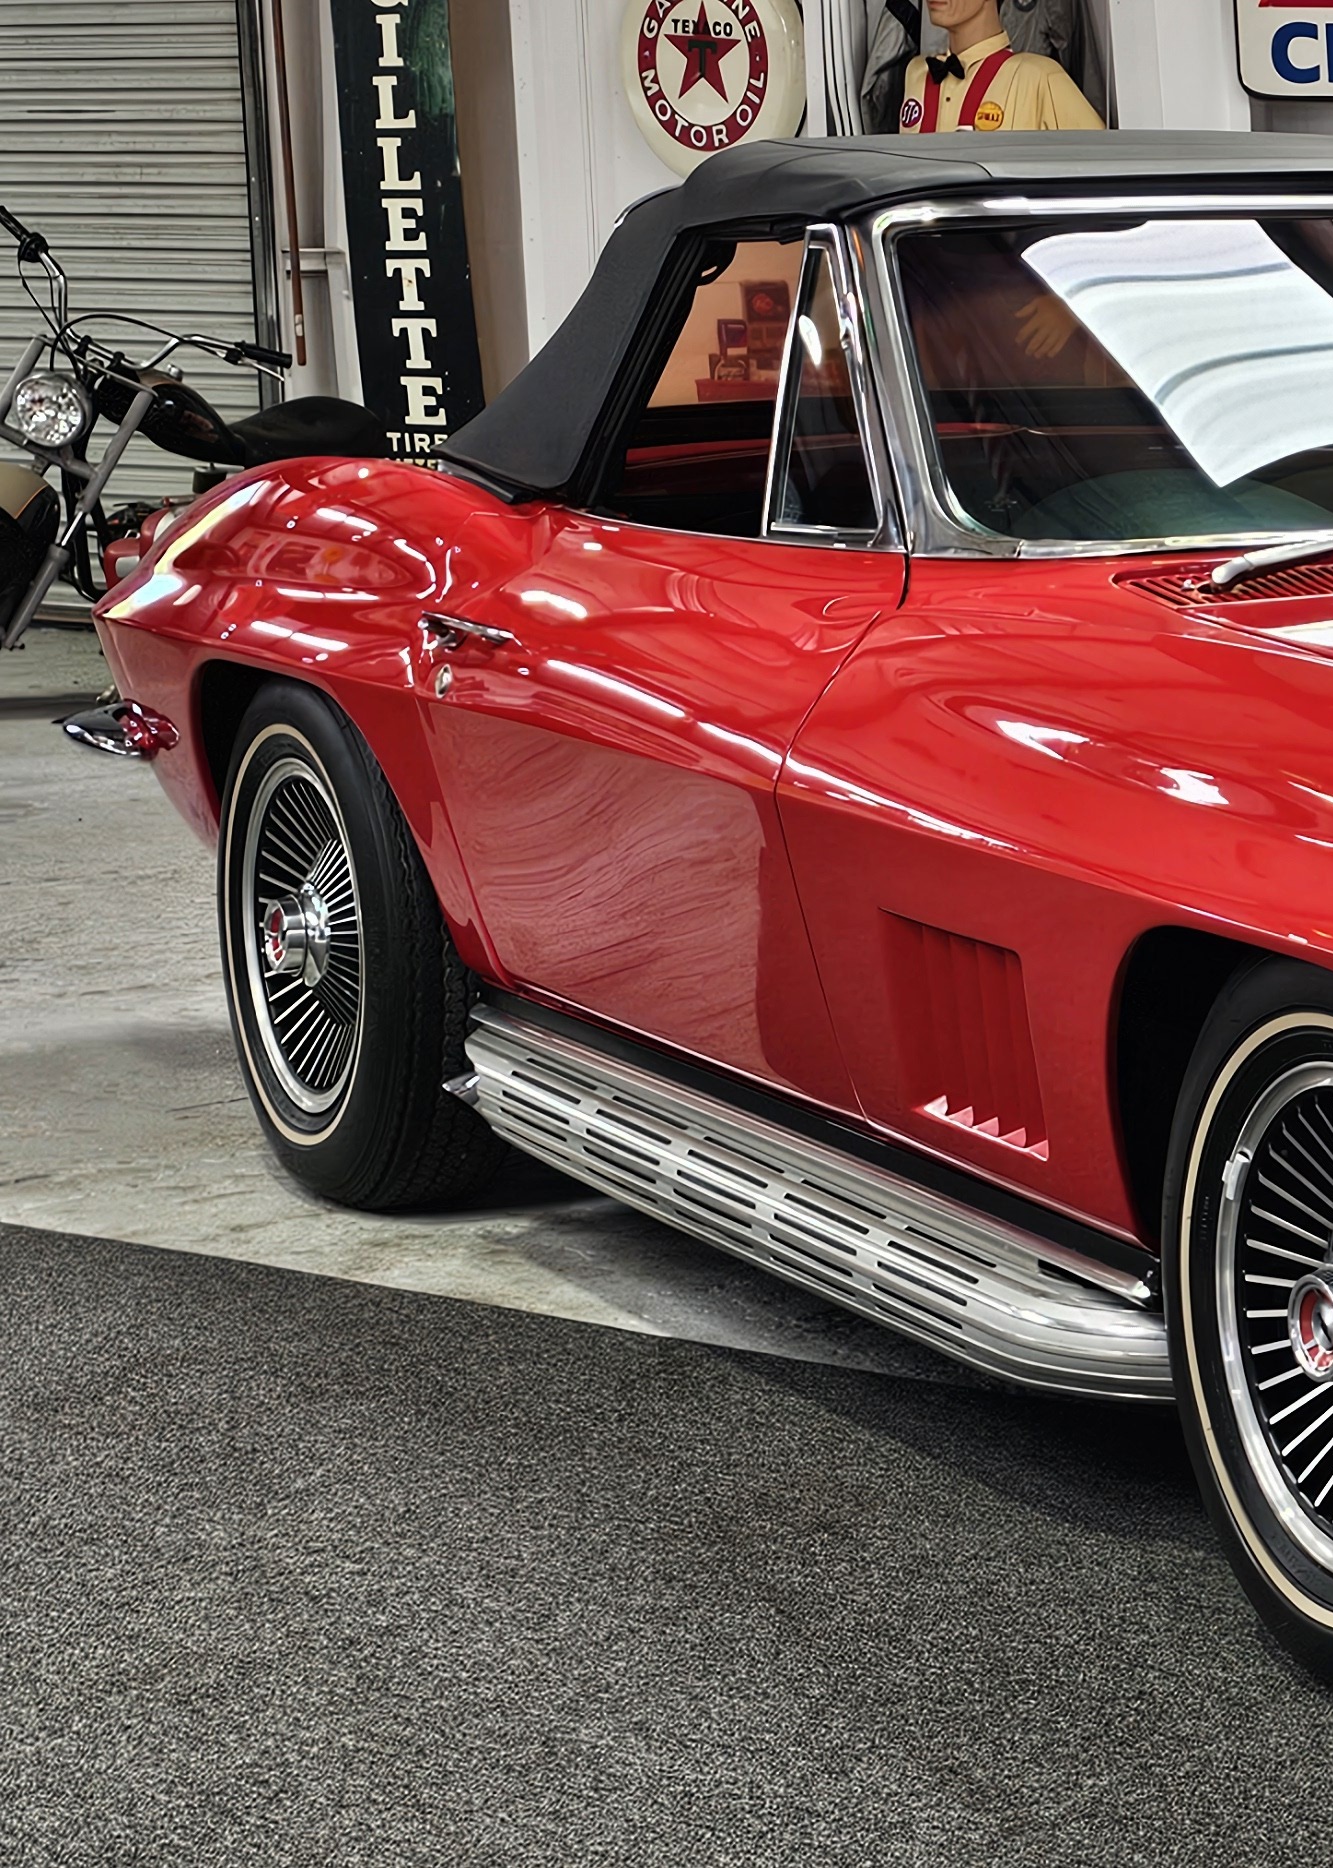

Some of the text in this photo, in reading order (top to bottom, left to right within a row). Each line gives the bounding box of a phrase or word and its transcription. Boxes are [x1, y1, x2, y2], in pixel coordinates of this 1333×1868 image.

[641, 69, 765, 147] MOTOR OIL
[902, 101, 919, 124] STP
[371, 0, 447, 426] ILLETTE
